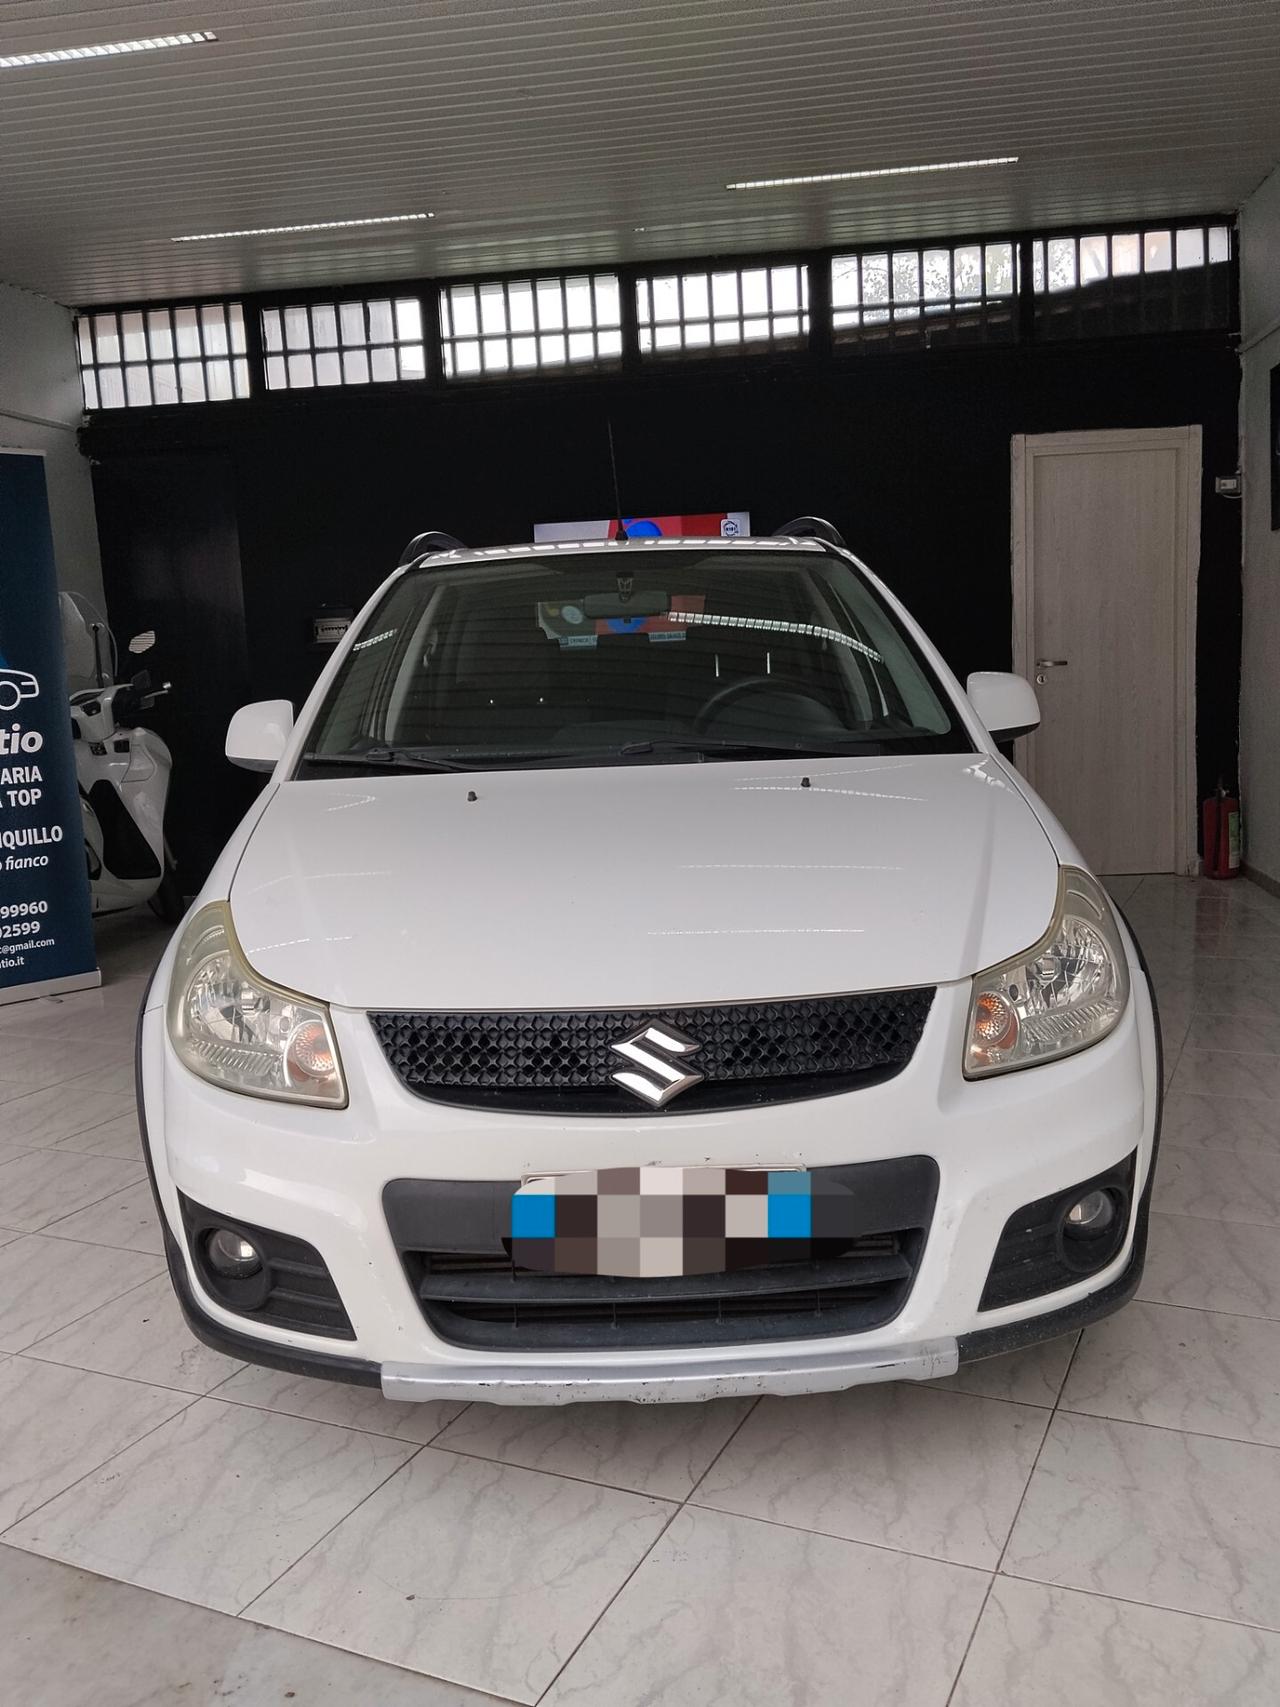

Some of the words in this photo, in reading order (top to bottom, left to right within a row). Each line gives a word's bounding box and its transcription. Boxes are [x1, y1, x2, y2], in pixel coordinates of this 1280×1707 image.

[0, 765, 43, 785] ARIA
[6, 788, 42, 807] TOP
[5, 855, 49, 870] fianco
[0, 900, 48, 919] 99960
[0, 921, 40, 938] 2599
[0, 956, 25, 968] tio.it
